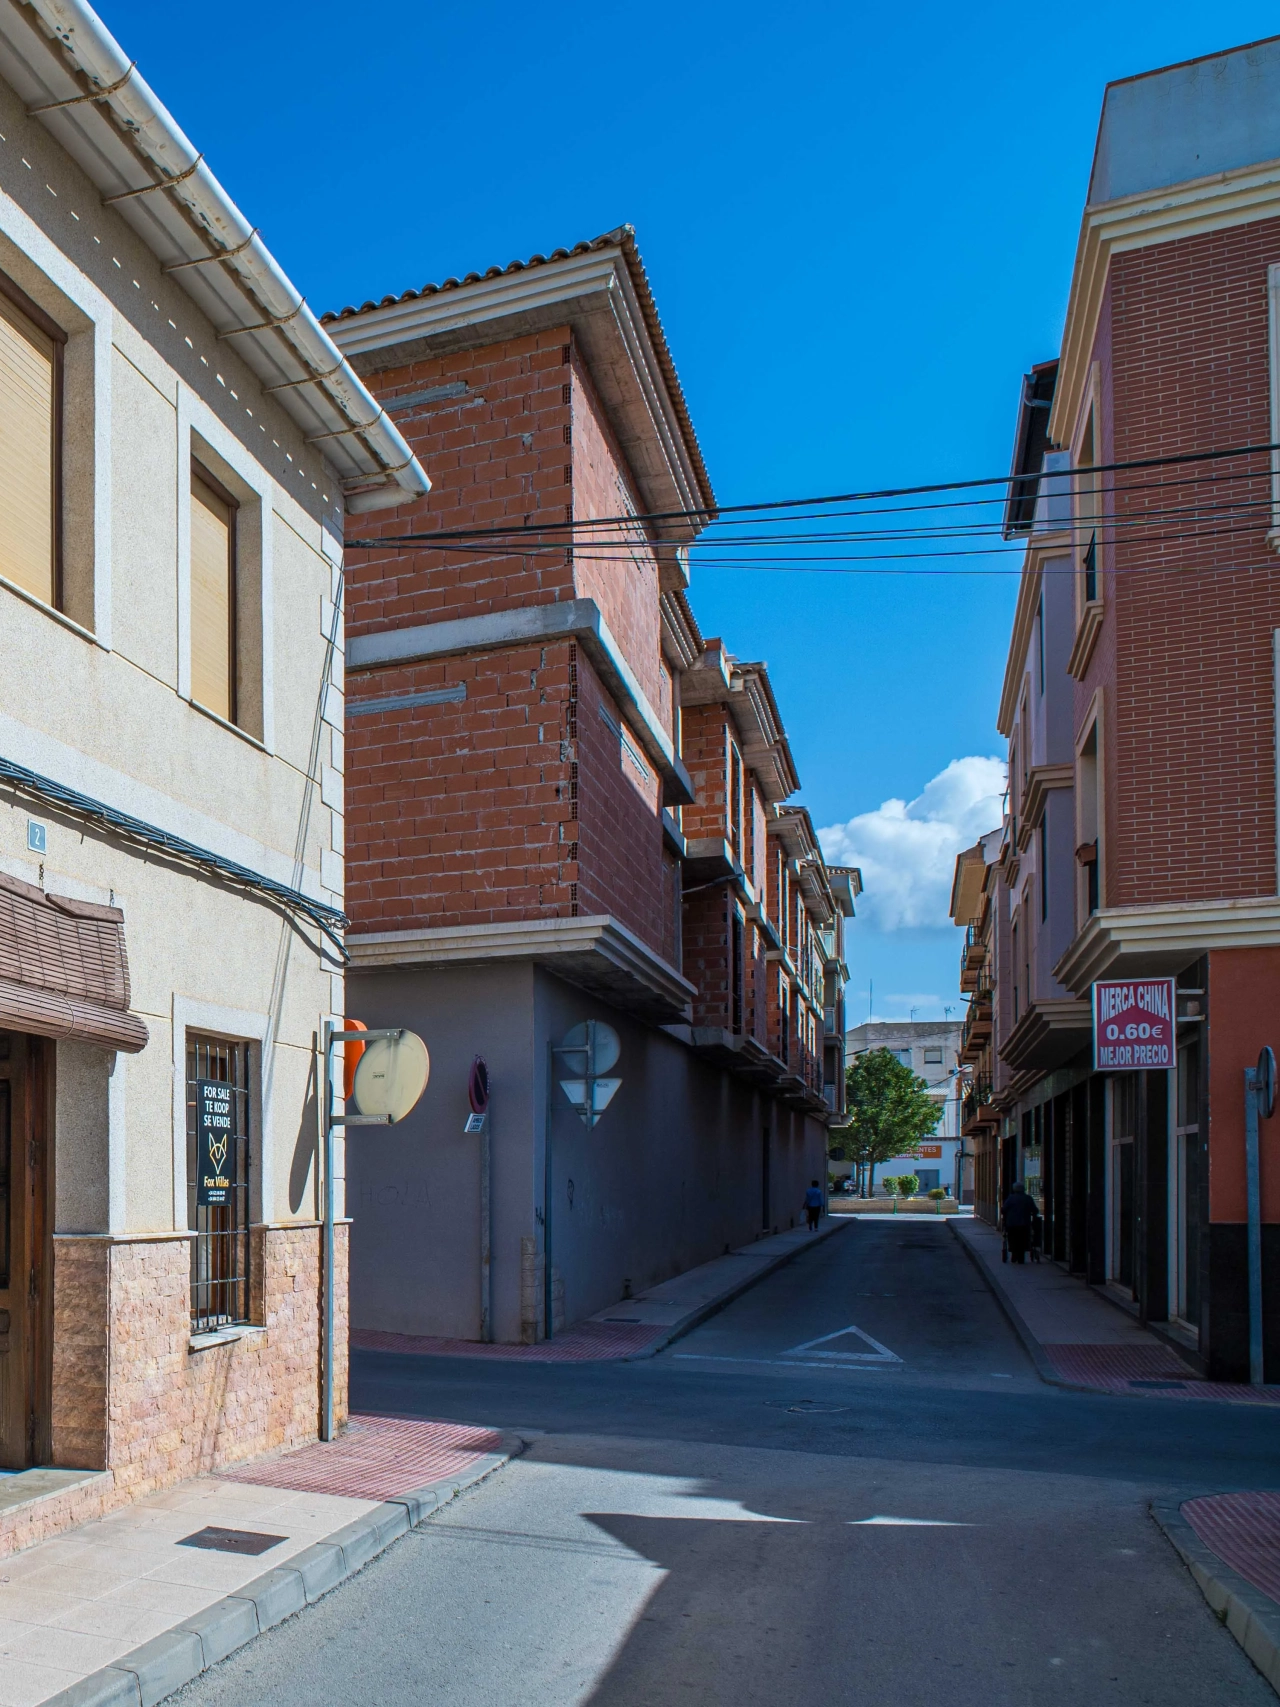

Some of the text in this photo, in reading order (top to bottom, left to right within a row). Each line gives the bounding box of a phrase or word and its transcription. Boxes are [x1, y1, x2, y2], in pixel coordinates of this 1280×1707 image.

[35, 828, 40, 846] 2
[1100, 983, 1170, 1025] MERCA CHINA
[1106, 1023, 1163, 1040] 0.60€
[1100, 1044, 1168, 1065] MEJOR PRECIO
[204, 1086, 230, 1100] FOR SALE
[205, 1101, 229, 1114] TE KOOP
[204, 1115, 230, 1128] SE VENDE
[204, 1176, 229, 1187] Fox Villas
